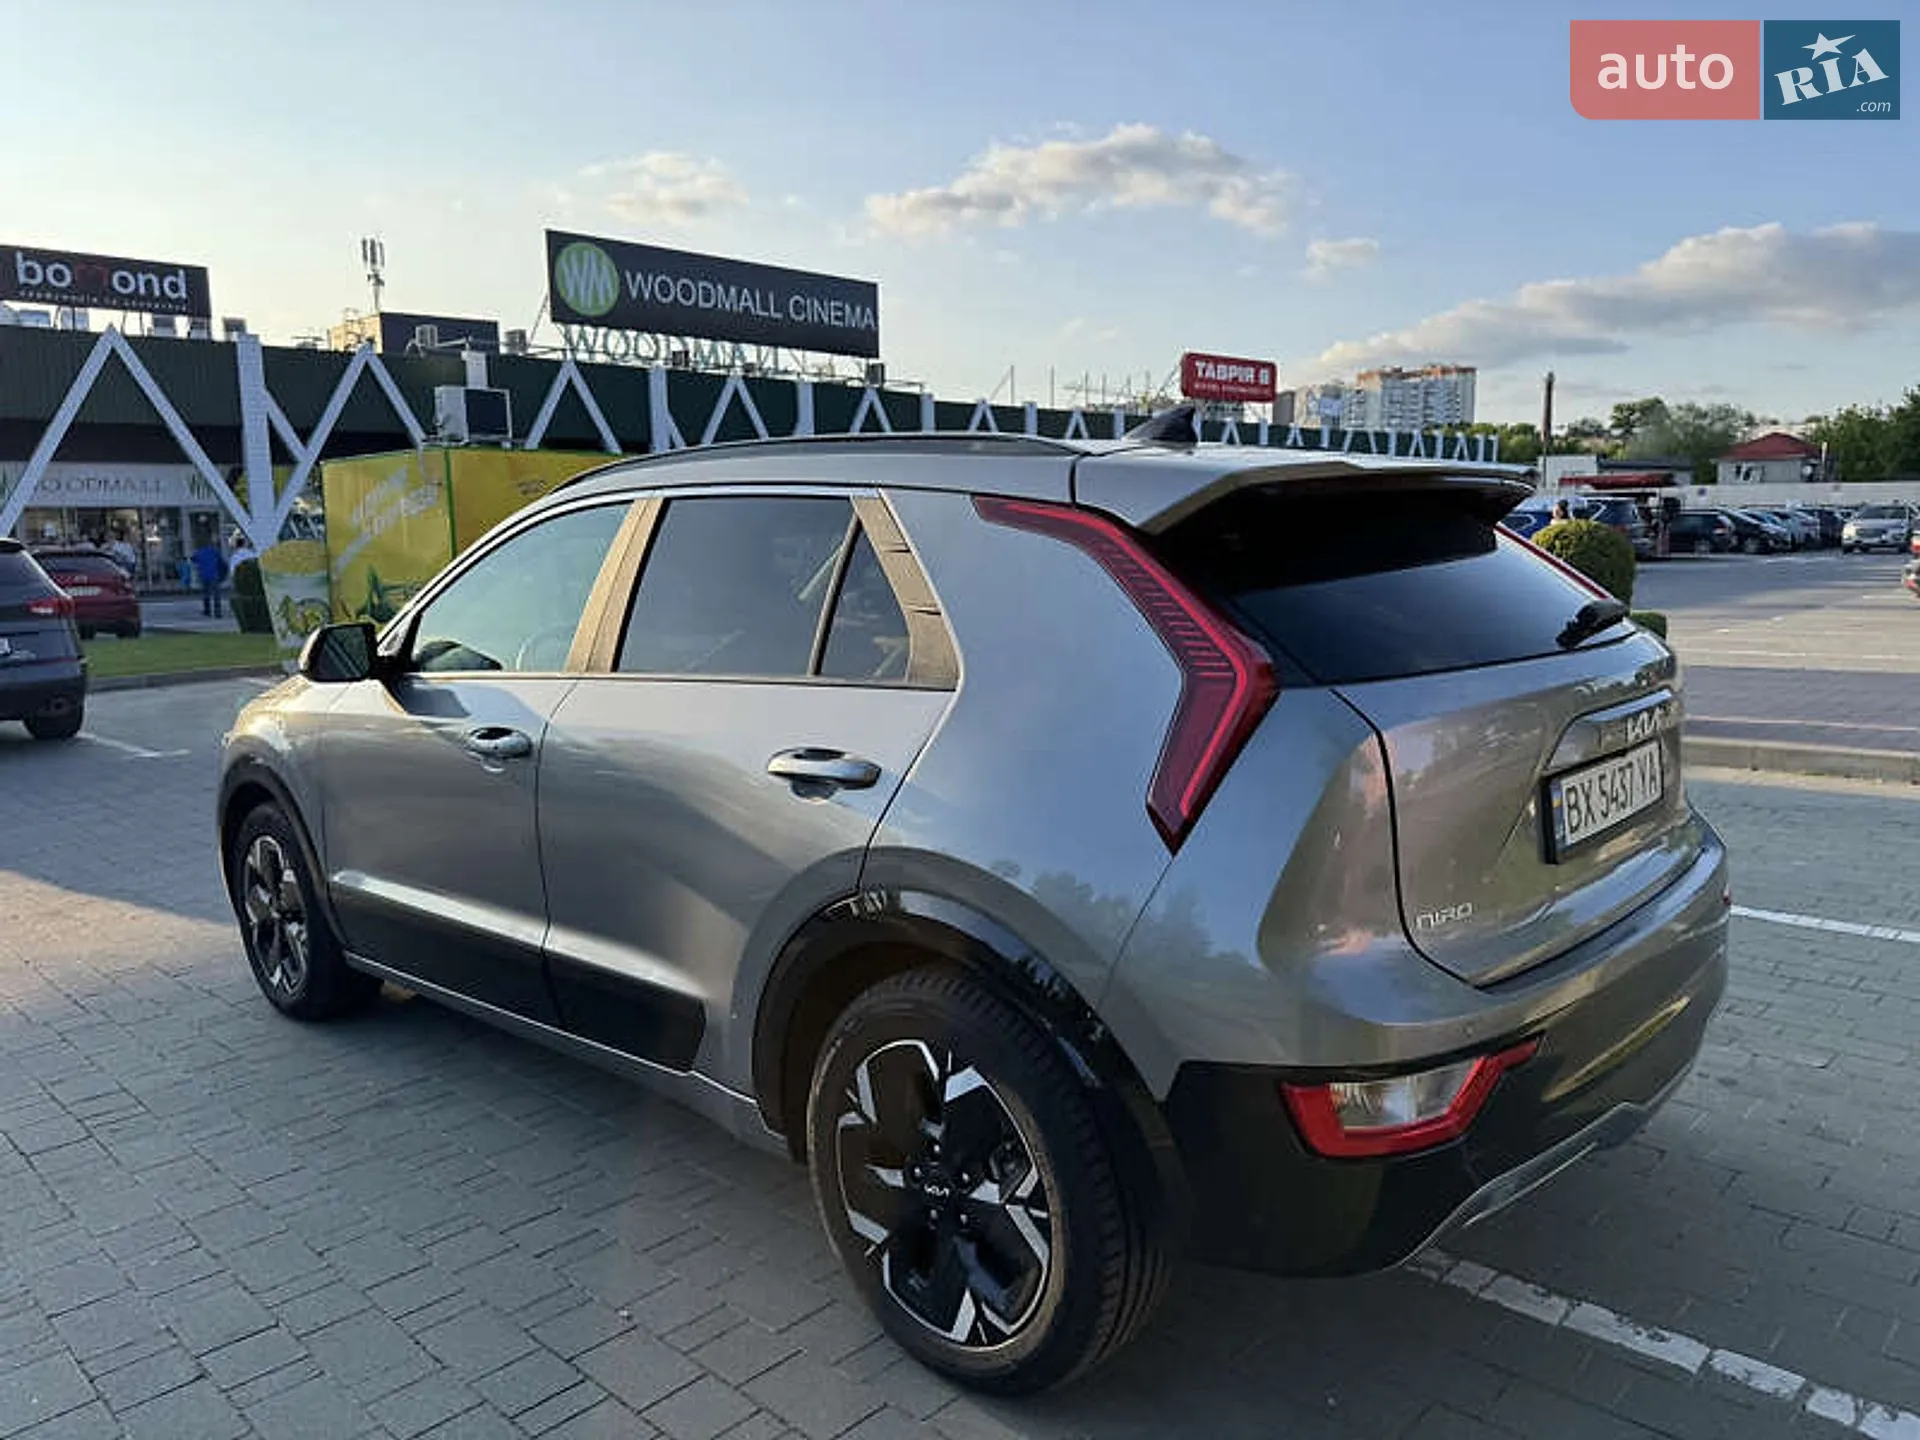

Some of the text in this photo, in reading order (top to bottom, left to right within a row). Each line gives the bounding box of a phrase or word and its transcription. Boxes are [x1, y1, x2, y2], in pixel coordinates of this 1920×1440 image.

[625, 270, 876, 331] WOODMALL CINEMA
[1565, 779, 1598, 834] BX
[1598, 761, 1634, 818] 5437
